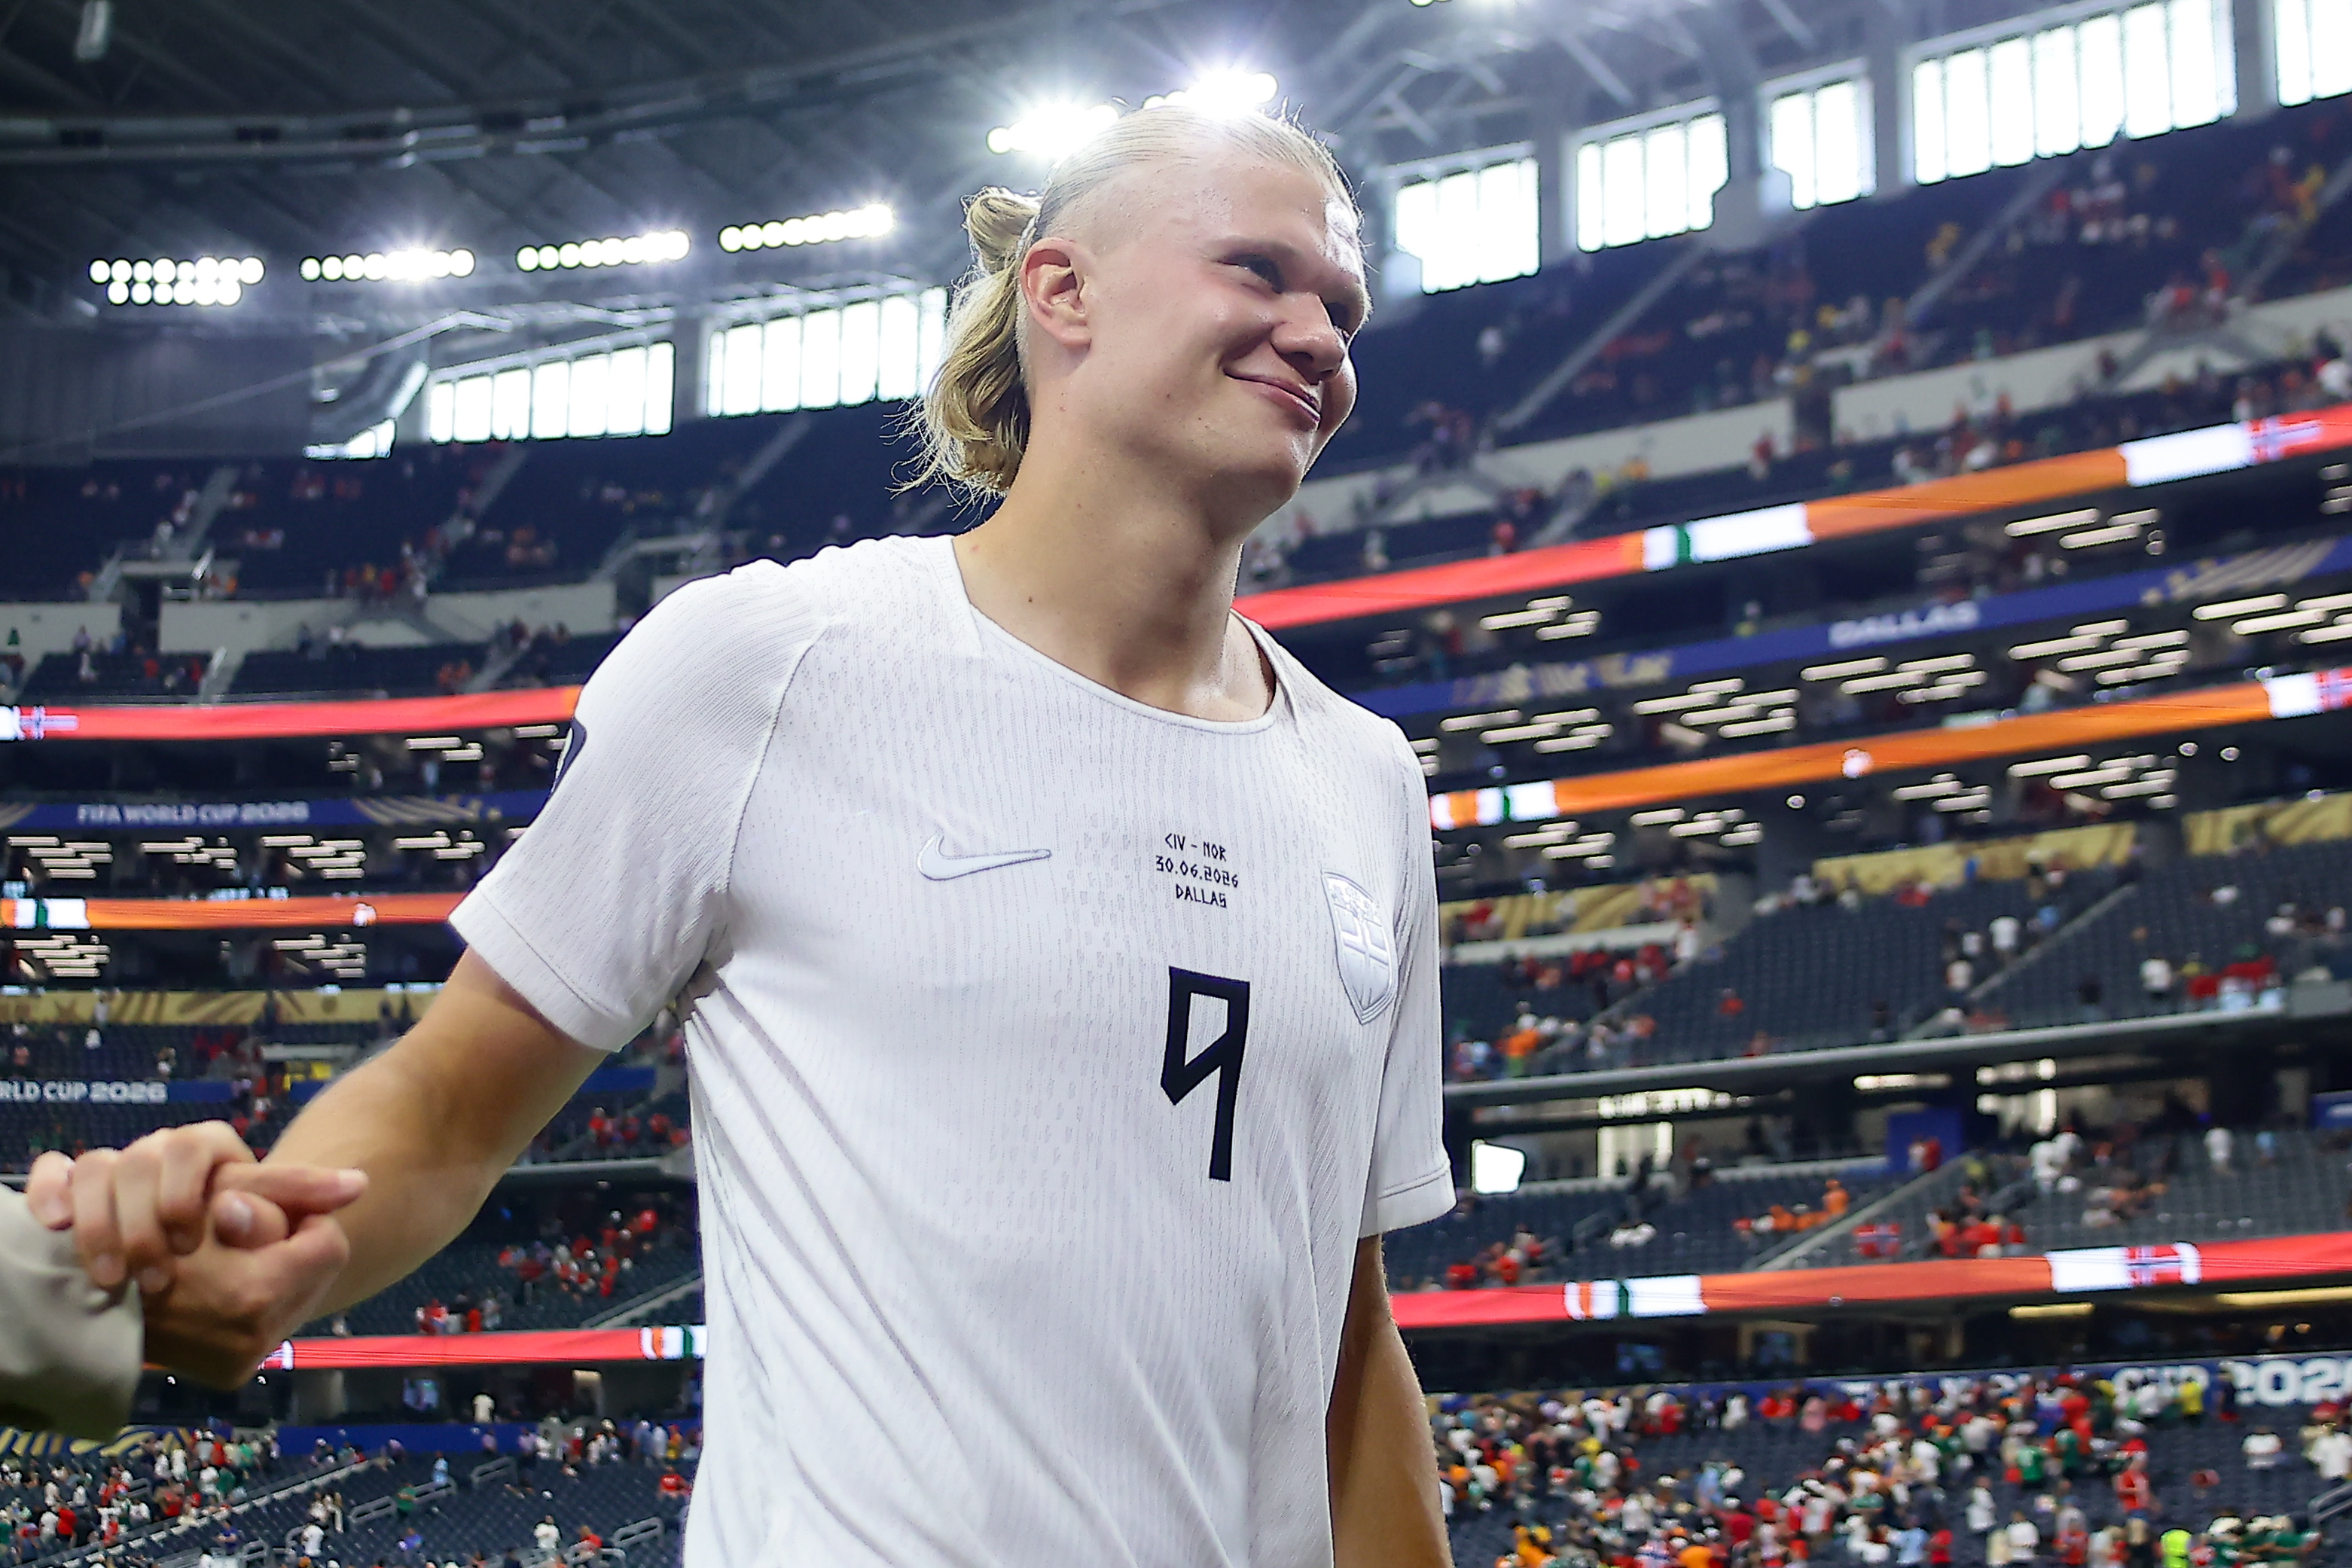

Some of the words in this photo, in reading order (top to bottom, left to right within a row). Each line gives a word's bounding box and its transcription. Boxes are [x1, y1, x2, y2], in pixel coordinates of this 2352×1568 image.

[78, 804, 121, 825] FIFA
[122, 804, 197, 825] WORLD
[197, 803, 239, 825] CUP
[1165, 833, 1185, 851] CIV
[1203, 840, 1226, 862] NOR
[1155, 855, 1238, 888] 30.06.2026
[1176, 883, 1227, 908] DALLAS
[1161, 966, 1250, 1182] 9
[43, 1080, 88, 1103] CUP
[89, 1080, 167, 1104] 2026
